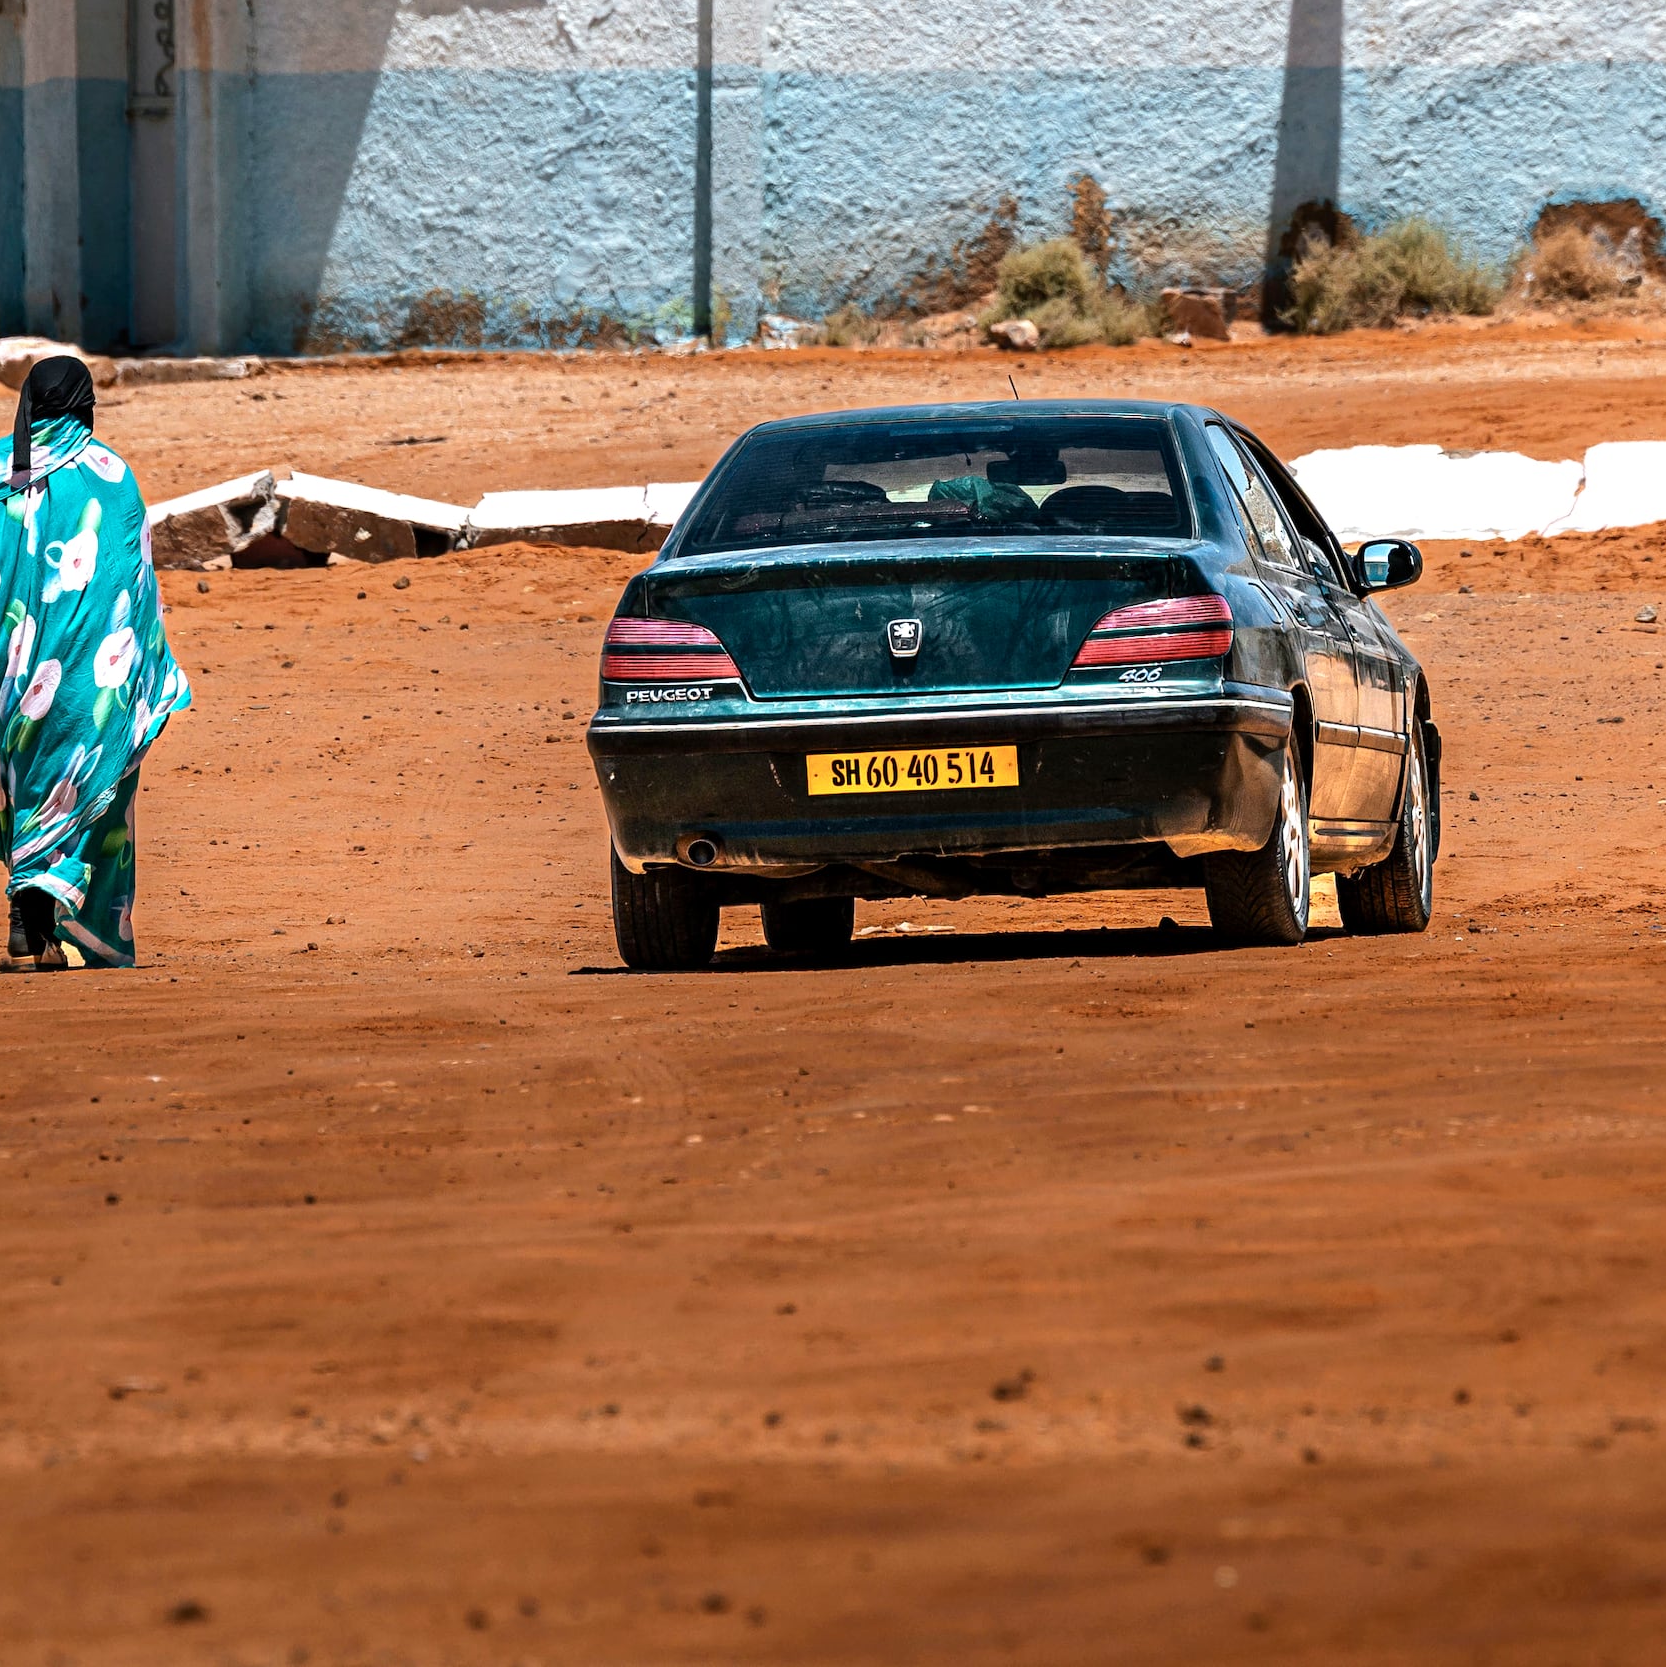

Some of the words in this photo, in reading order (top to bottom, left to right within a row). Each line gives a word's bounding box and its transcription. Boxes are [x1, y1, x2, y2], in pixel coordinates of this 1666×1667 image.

[1118, 667, 1162, 682] 406
[626, 687, 713, 703] PEUGEOT
[832, 758, 861, 787] SH
[866, 756, 898, 788] 60
[907, 754, 938, 786] 40
[947, 751, 995, 784] 514
